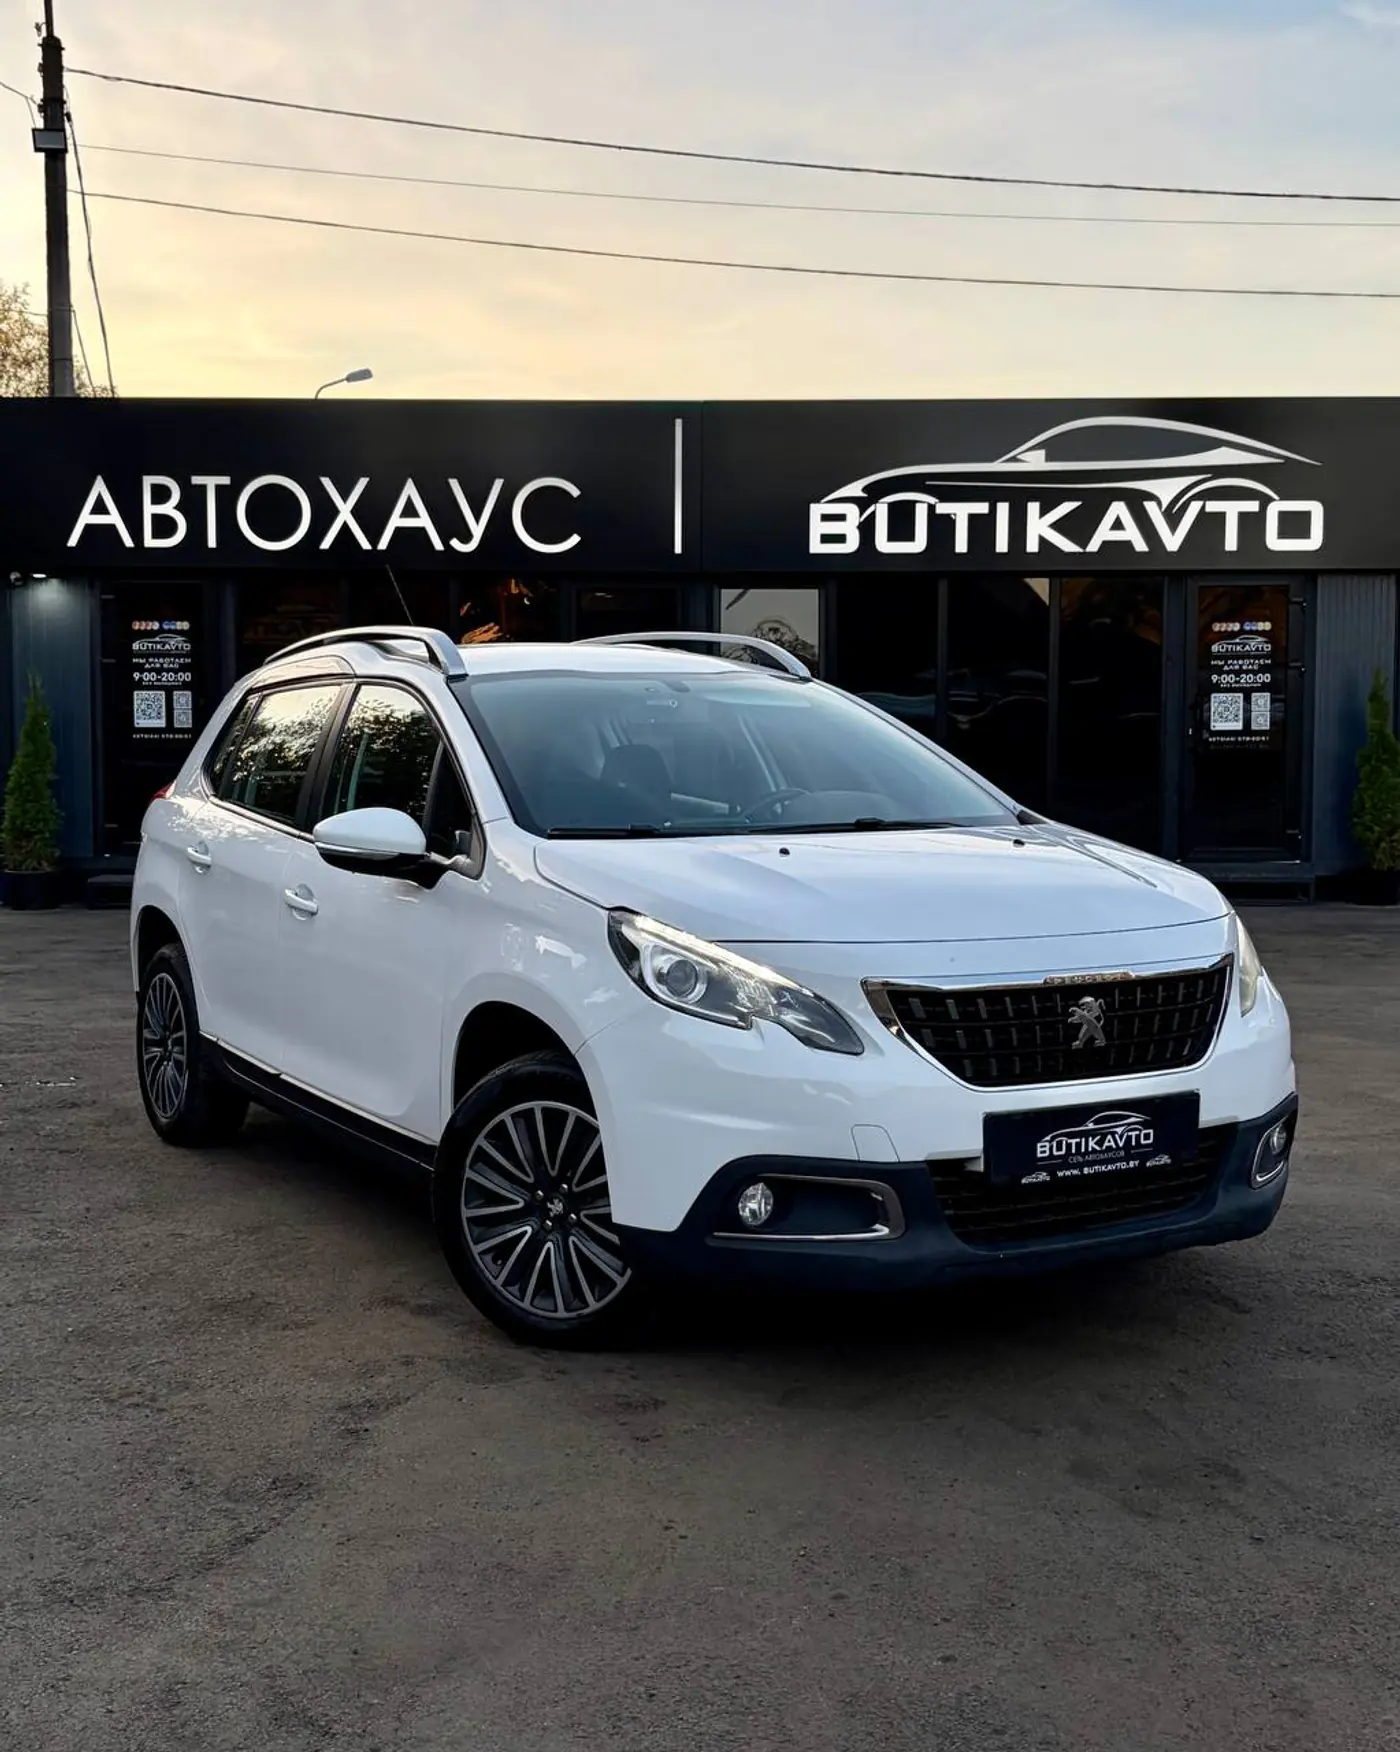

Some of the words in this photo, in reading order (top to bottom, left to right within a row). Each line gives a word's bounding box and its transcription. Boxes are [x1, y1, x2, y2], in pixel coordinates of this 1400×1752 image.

[66, 474, 582, 554] АВТОХАУС
[808, 499, 1325, 555] BUTIKAVTO
[132, 642, 191, 650] BUTIKAVTO
[1211, 643, 1272, 652] BUTIKAVTO
[1211, 673, 1271, 683] 9:00-20:00
[1036, 1128, 1154, 1158] BUTIKAVTO
[1083, 1160, 1140, 1175] BUTIKAVTO.BY
